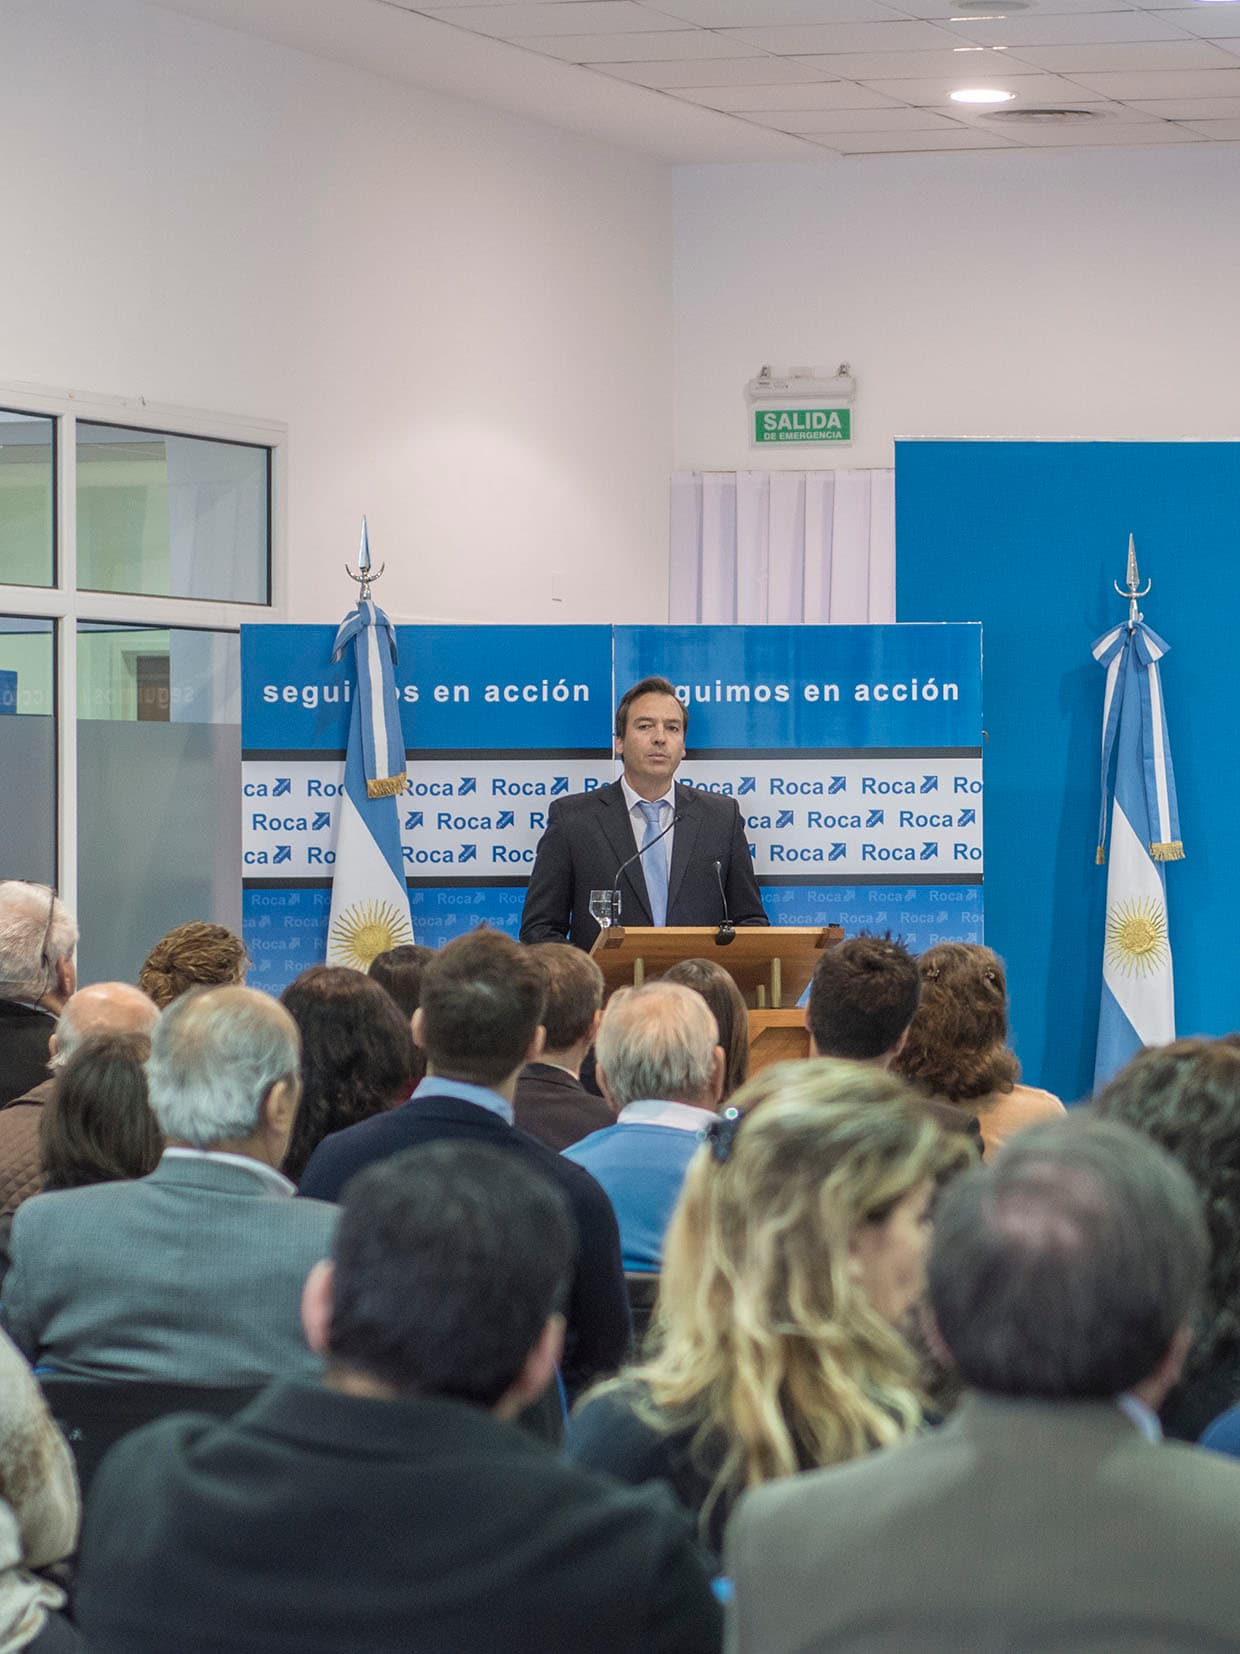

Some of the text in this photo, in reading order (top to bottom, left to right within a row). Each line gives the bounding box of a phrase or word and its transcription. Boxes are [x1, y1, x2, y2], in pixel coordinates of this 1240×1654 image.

[763, 411, 842, 431] SALIDA
[763, 431, 842, 440] DE EMERGENCIA
[262, 679, 590, 708] seguis en acción
[674, 678, 959, 708] guimos en acción
[243, 783, 268, 797] ca
[307, 779, 344, 797] Ro
[492, 778, 546, 796] Roca
[769, 778, 824, 796] Roca
[861, 777, 916, 795] Roca
[953, 776, 982, 794] Ro
[252, 812, 492, 831] Roca Roca
[745, 810, 953, 829] ca Roca Roca
[243, 845, 538, 864] ca Ro Roca Roc
[769, 843, 982, 862] Roca Roca Ro
[251, 894, 286, 906] Roca
[437, 893, 472, 905] Roca
[499, 892, 526, 904] Roc
[807, 891, 842, 902] Roca
[868, 890, 903, 902] Roca
[929, 890, 964, 901] Roca
[284, 916, 319, 928] Roca
[778, 911, 984, 924] Roca Roca Roca Roc
[252, 938, 286, 950] Roca
